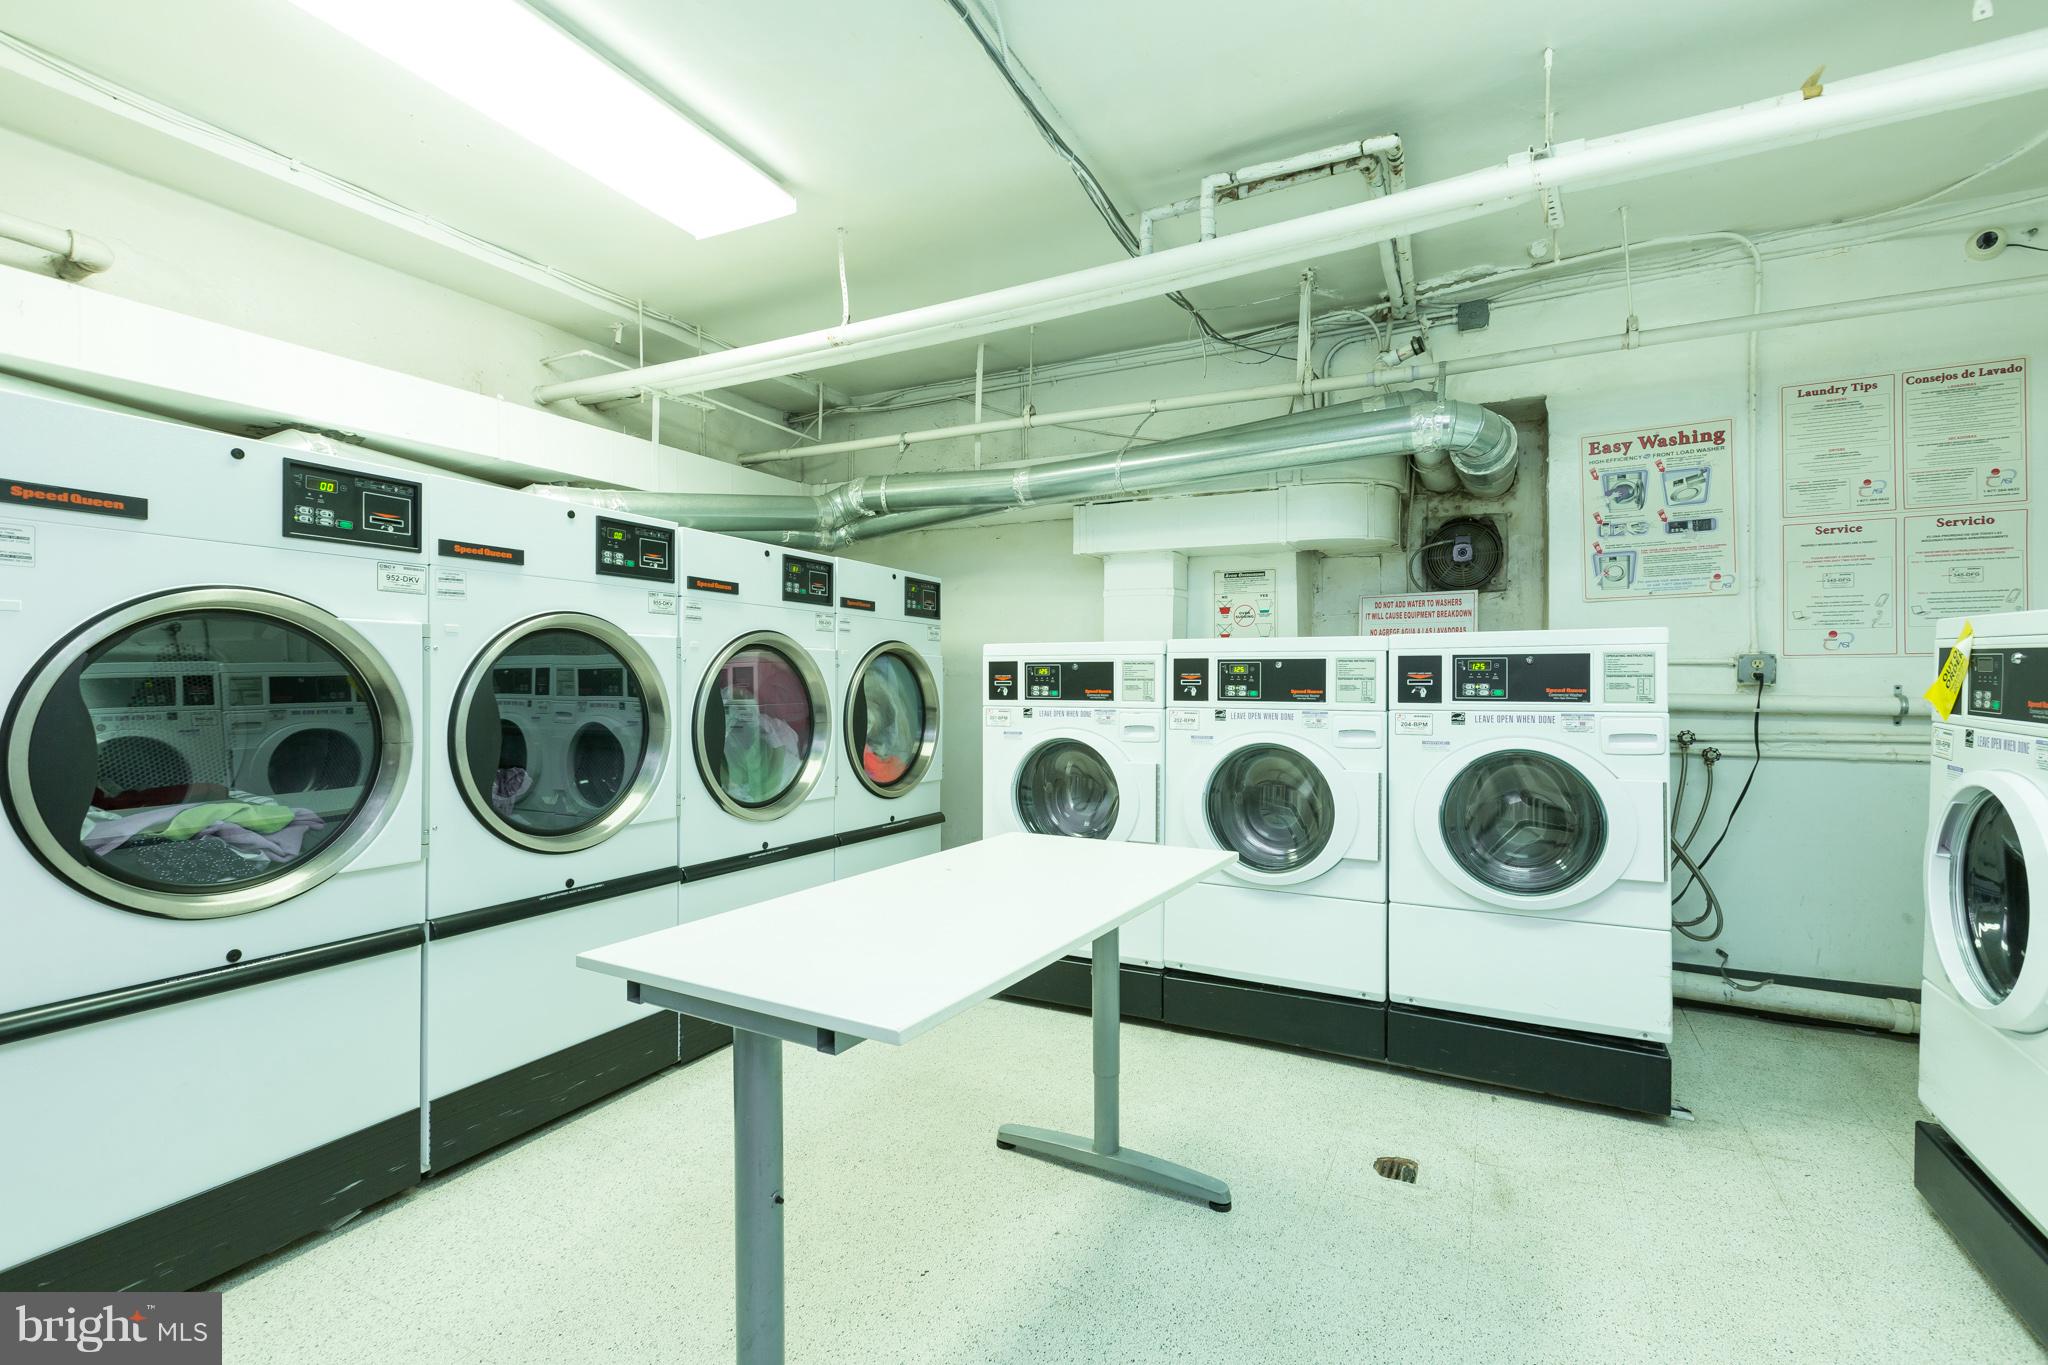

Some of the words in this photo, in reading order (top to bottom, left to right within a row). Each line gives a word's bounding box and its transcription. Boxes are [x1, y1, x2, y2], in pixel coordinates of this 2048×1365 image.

[1906, 373, 1958, 385] Consejos
[1961, 369, 1975, 379] de
[1979, 364, 2023, 377] Lavado
[1797, 385, 1848, 398] Laundry
[1851, 382, 1878, 393] Tips
[1588, 440, 1633, 456] Easy
[1637, 430, 1726, 450] Washing
[1605, 455, 1642, 464] EFFICIENCY
[1696, 445, 1725, 454] WASHER
[320, 481, 334, 492] 00
[10, 485, 69, 502] Speed
[70, 493, 125, 510] Queen
[1936, 515, 1995, 528] Servicio
[1815, 524, 1863, 536] Service
[454, 544, 484, 556] Speed
[484, 548, 513, 560] Queen
[386, 574, 420, 583] 952-DKV
[697, 580, 715, 588] Speed
[715, 582, 732, 591] Queen
[1374, 601, 1382, 609] DO
[1382, 600, 1394, 609] NOT
[1395, 600, 1406, 608] ADD
[1406, 599, 1426, 608] WATER
[1426, 599, 1434, 607] TO
[1435, 598, 1463, 607] WASHERS
[1365, 612, 1371, 620] IT
[1371, 612, 1384, 620] WILL
[1385, 611, 1403, 620] CAUSE
[1404, 610, 1436, 619] EQUIPMENT
[1436, 609, 1473, 618] BREAKDOWN
[1370, 628, 1378, 636] NO
[1472, 662, 1485, 670] 125
[1039, 709, 1052, 718] LEAVE
[1053, 709, 1065, 718] OPEN
[1066, 710, 1079, 718] WHEN
[1080, 710, 1092, 718] DONE
[1230, 711, 1246, 720] LEAVE
[1247, 711, 1262, 720] OPEN
[1263, 712, 1279, 721] WHEN
[1280, 712, 1294, 721] DONE
[1474, 714, 1494, 723] LEAVE
[1496, 714, 1514, 724] OPEN
[1516, 715, 1536, 724] WHEN
[1538, 715, 1556, 724] DONE
[1977, 735, 1991, 749] LEAVE
[1991, 737, 2003, 750] OPEN
[2003, 739, 2017, 753] WHEN
[2018, 741, 2030, 754] DONE
